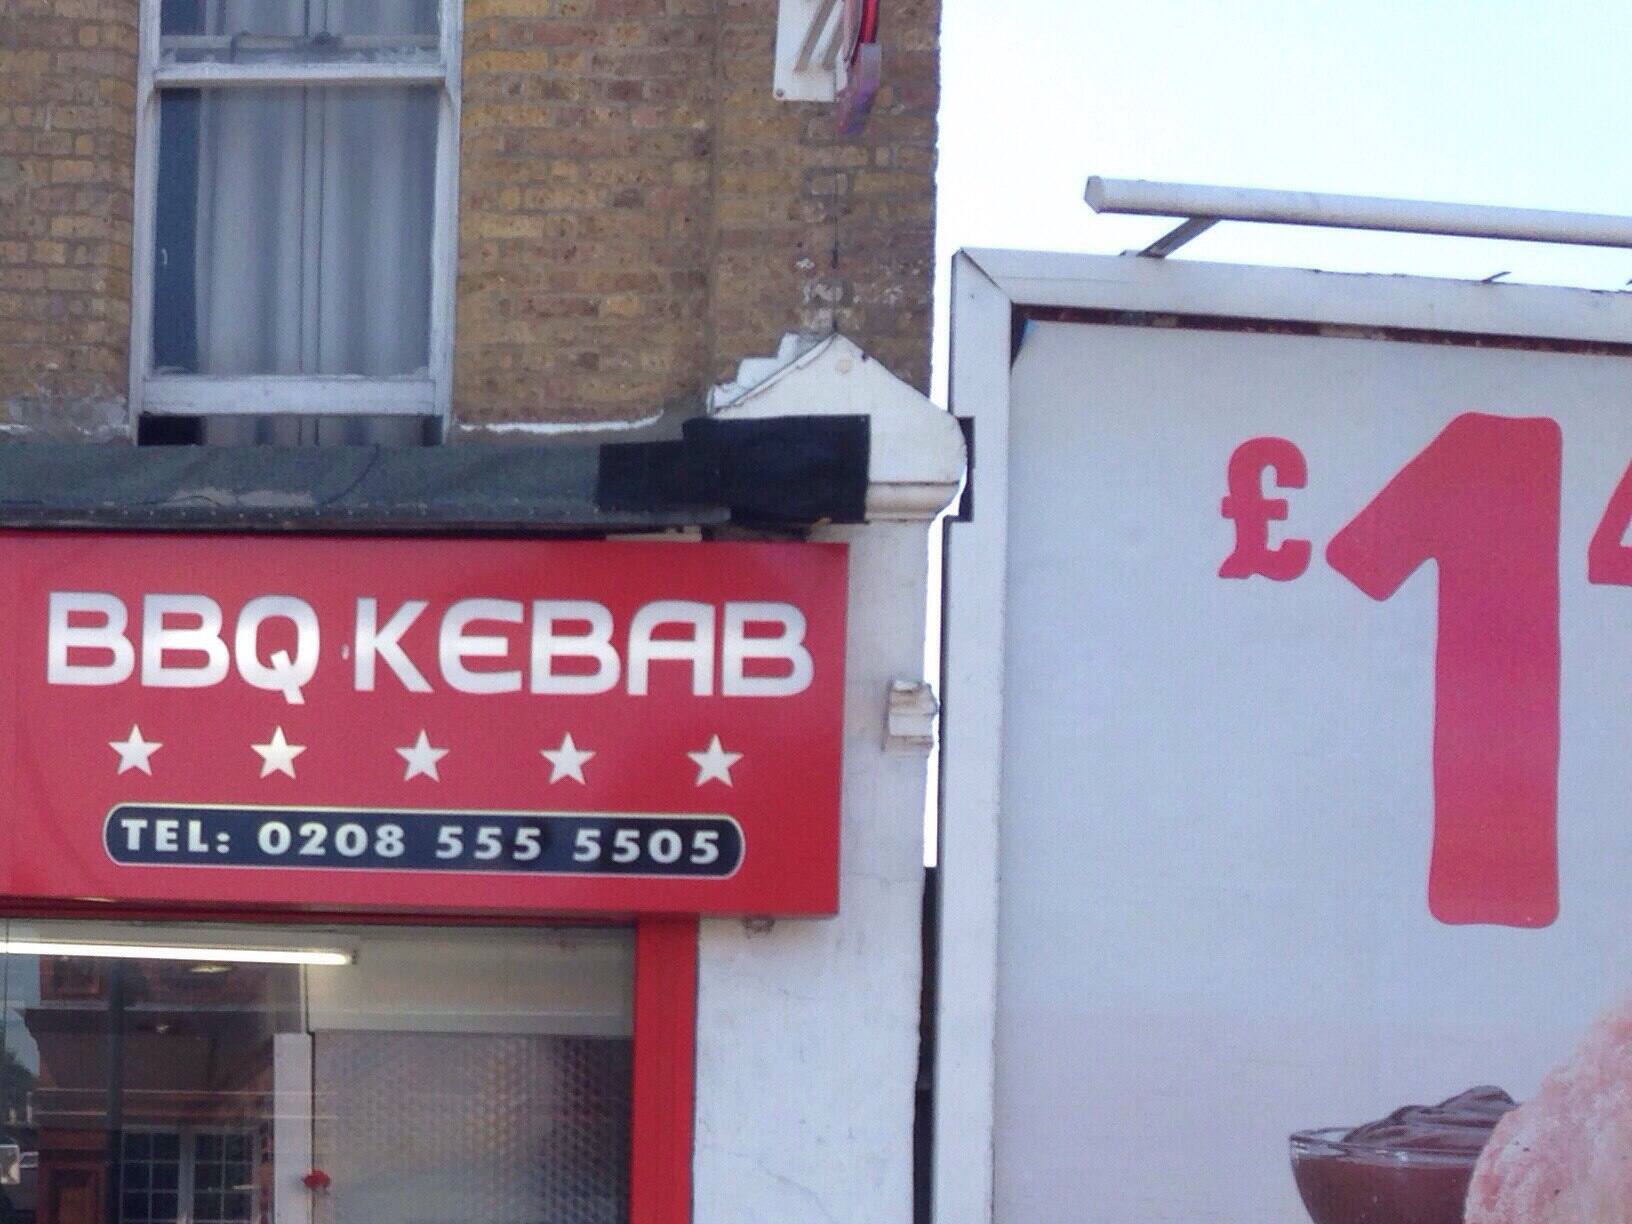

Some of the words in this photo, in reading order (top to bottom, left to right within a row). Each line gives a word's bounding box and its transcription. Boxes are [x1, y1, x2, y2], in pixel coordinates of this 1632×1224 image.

[45, 591, 321, 705] BBQ
[353, 596, 815, 698] KEBAB
[121, 818, 232, 855] TEL:
[258, 820, 406, 857] 0208
[435, 824, 543, 861] 555
[573, 827, 722, 865] 5505
